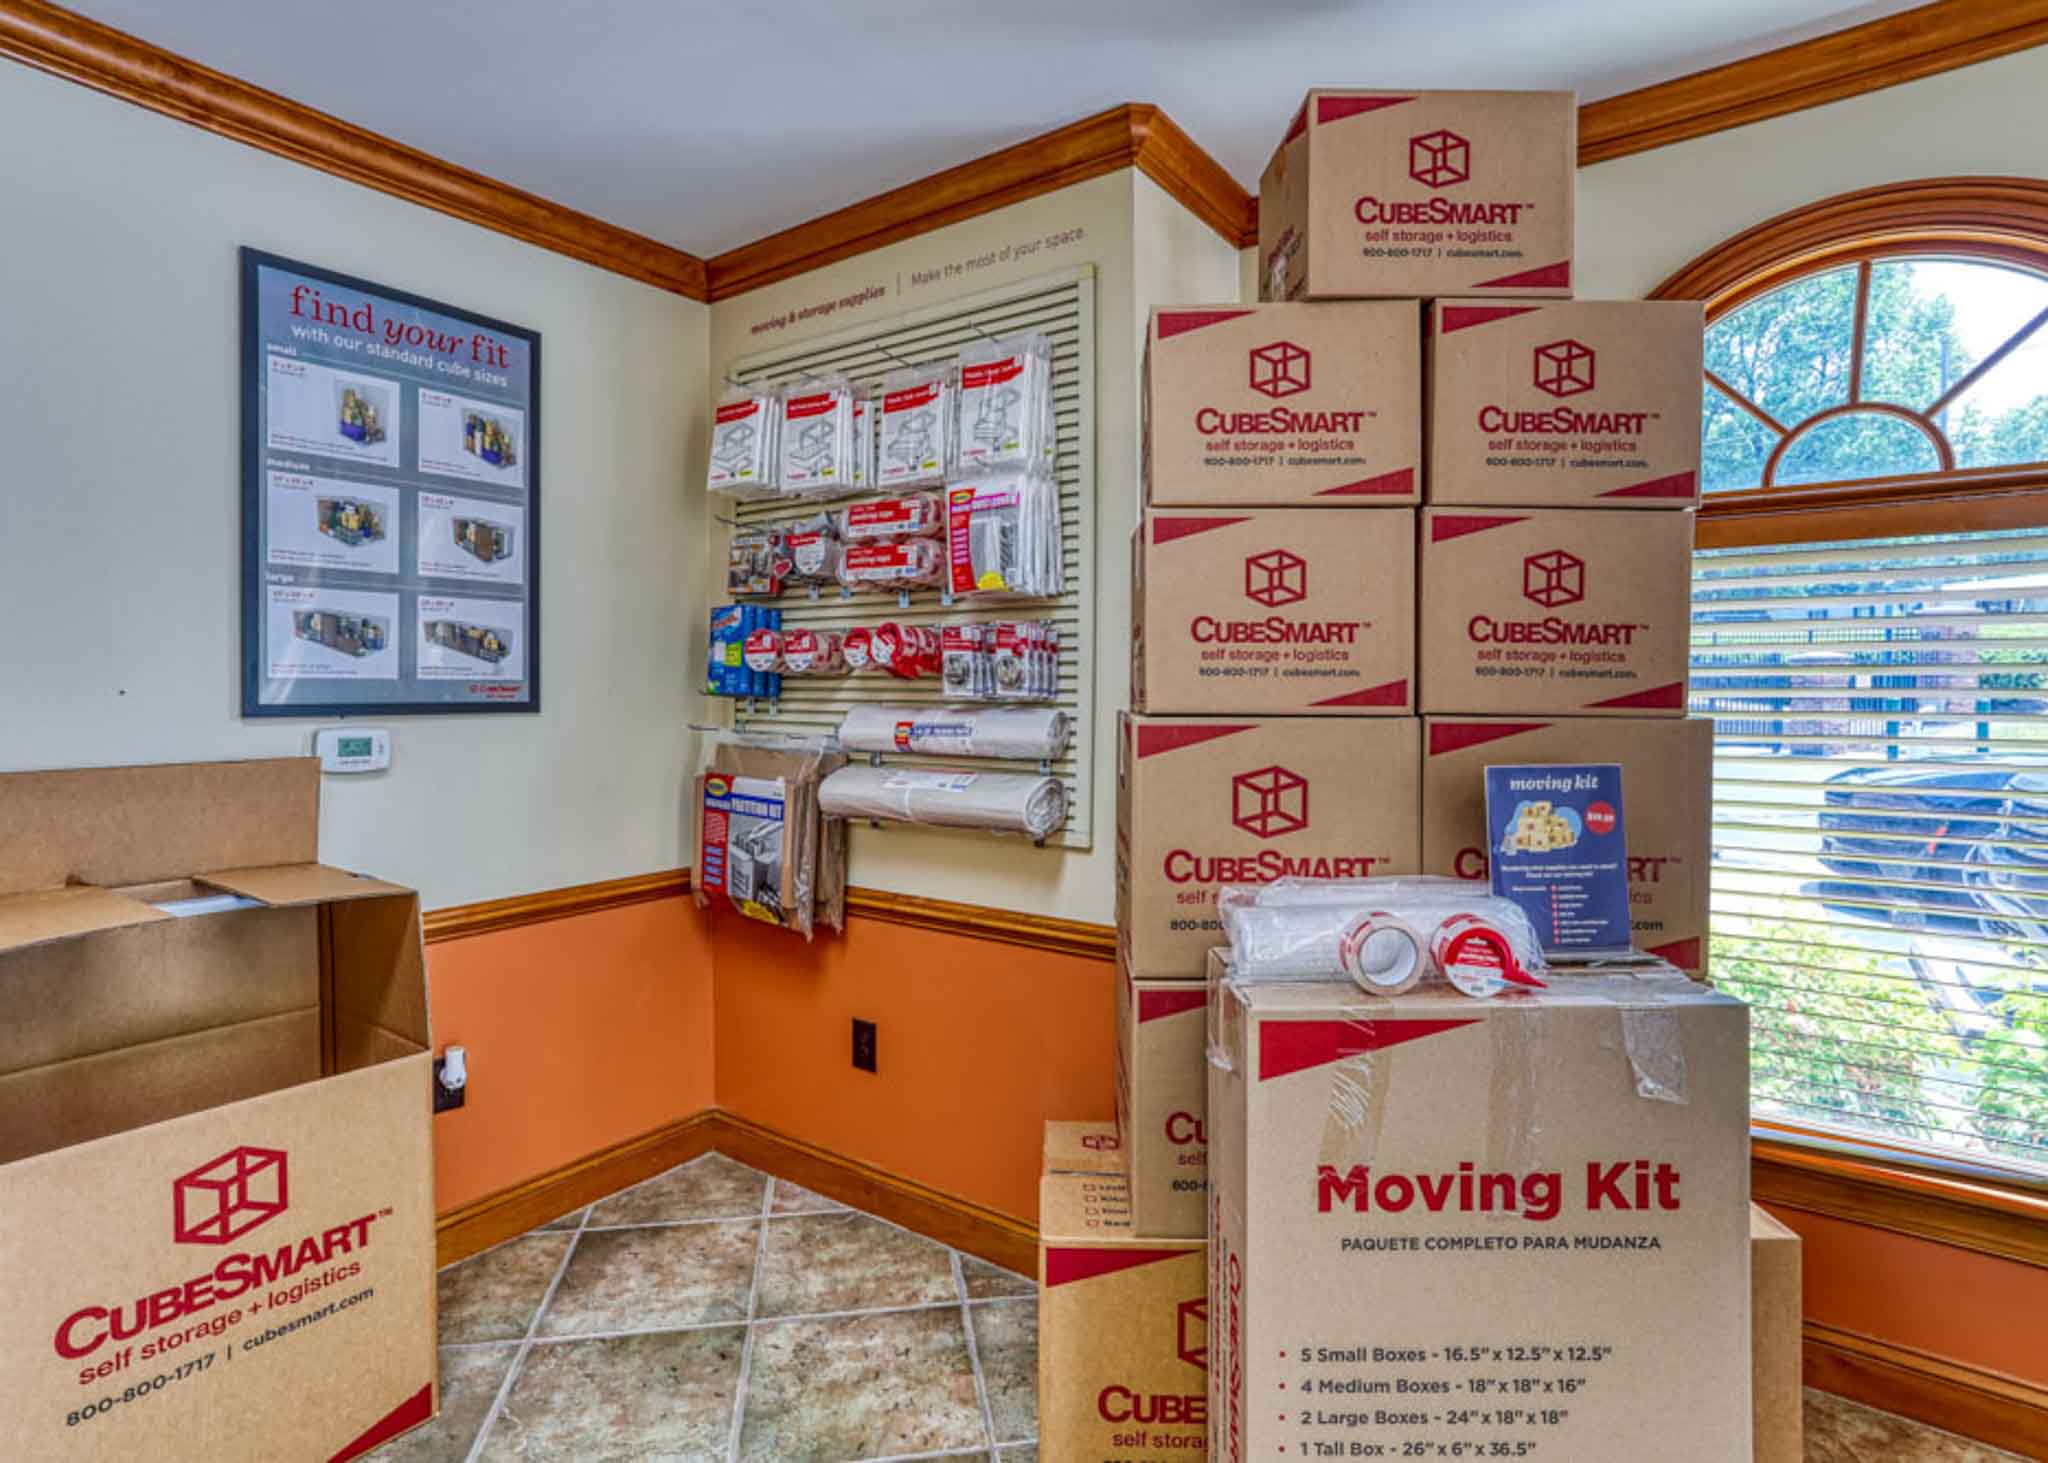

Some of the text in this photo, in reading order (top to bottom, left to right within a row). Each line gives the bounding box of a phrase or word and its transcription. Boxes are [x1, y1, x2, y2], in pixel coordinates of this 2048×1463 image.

[1365, 229, 1389, 242] self
[1392, 231, 1443, 245] storage
[1456, 230, 1512, 245] logistics
[911, 269, 941, 287] Make
[944, 262, 962, 278] the
[966, 254, 996, 274] most
[999, 249, 1011, 264] of
[1012, 240, 1041, 264] your
[290, 284, 511, 369] find your fit
[290, 325, 508, 388] with our standard cube sizes
[1205, 439, 1230, 451] self
[1234, 440, 1284, 453] storage
[1297, 439, 1354, 453] logistics
[1488, 439, 1513, 451] self
[1516, 440, 1566, 453] storage
[1580, 440, 1637, 453] logistics
[1201, 649, 1225, 661] self
[1229, 650, 1280, 663] storage
[1293, 649, 1349, 663] logistics
[1477, 649, 1502, 661] self
[1505, 650, 1556, 663] storage
[1569, 650, 1626, 664] logistics
[1510, 773, 1598, 793] moving kit
[1176, 891, 1206, 905] self
[1317, 1160, 1681, 1221] Moving Kit
[1341, 1235, 1662, 1251] PAQUETE COMPLETO PARA MUDANZA
[78, 1346, 134, 1386] self
[140, 1307, 243, 1361] storage
[267, 1261, 362, 1310] logistics
[65, 1287, 375, 1427] 800-800-1717 cubesmart.com
[1301, 1348, 1312, 1362] 5
[1317, 1347, 1367, 1362] Small
[1372, 1348, 1426, 1362] Boxes
[1301, 1379, 1312, 1393] 4
[1319, 1378, 1390, 1393] Medium
[1396, 1378, 1449, 1393] Boxes
[1301, 1411, 1312, 1424] 2
[1317, 1411, 1369, 1427] Large
[1374, 1410, 1428, 1425] Boxes
[1112, 1430, 1147, 1448] self
[1301, 1442, 1308, 1456] 1
[1313, 1442, 1345, 1456] Tall
[1350, 1442, 1384, 1456] Box
